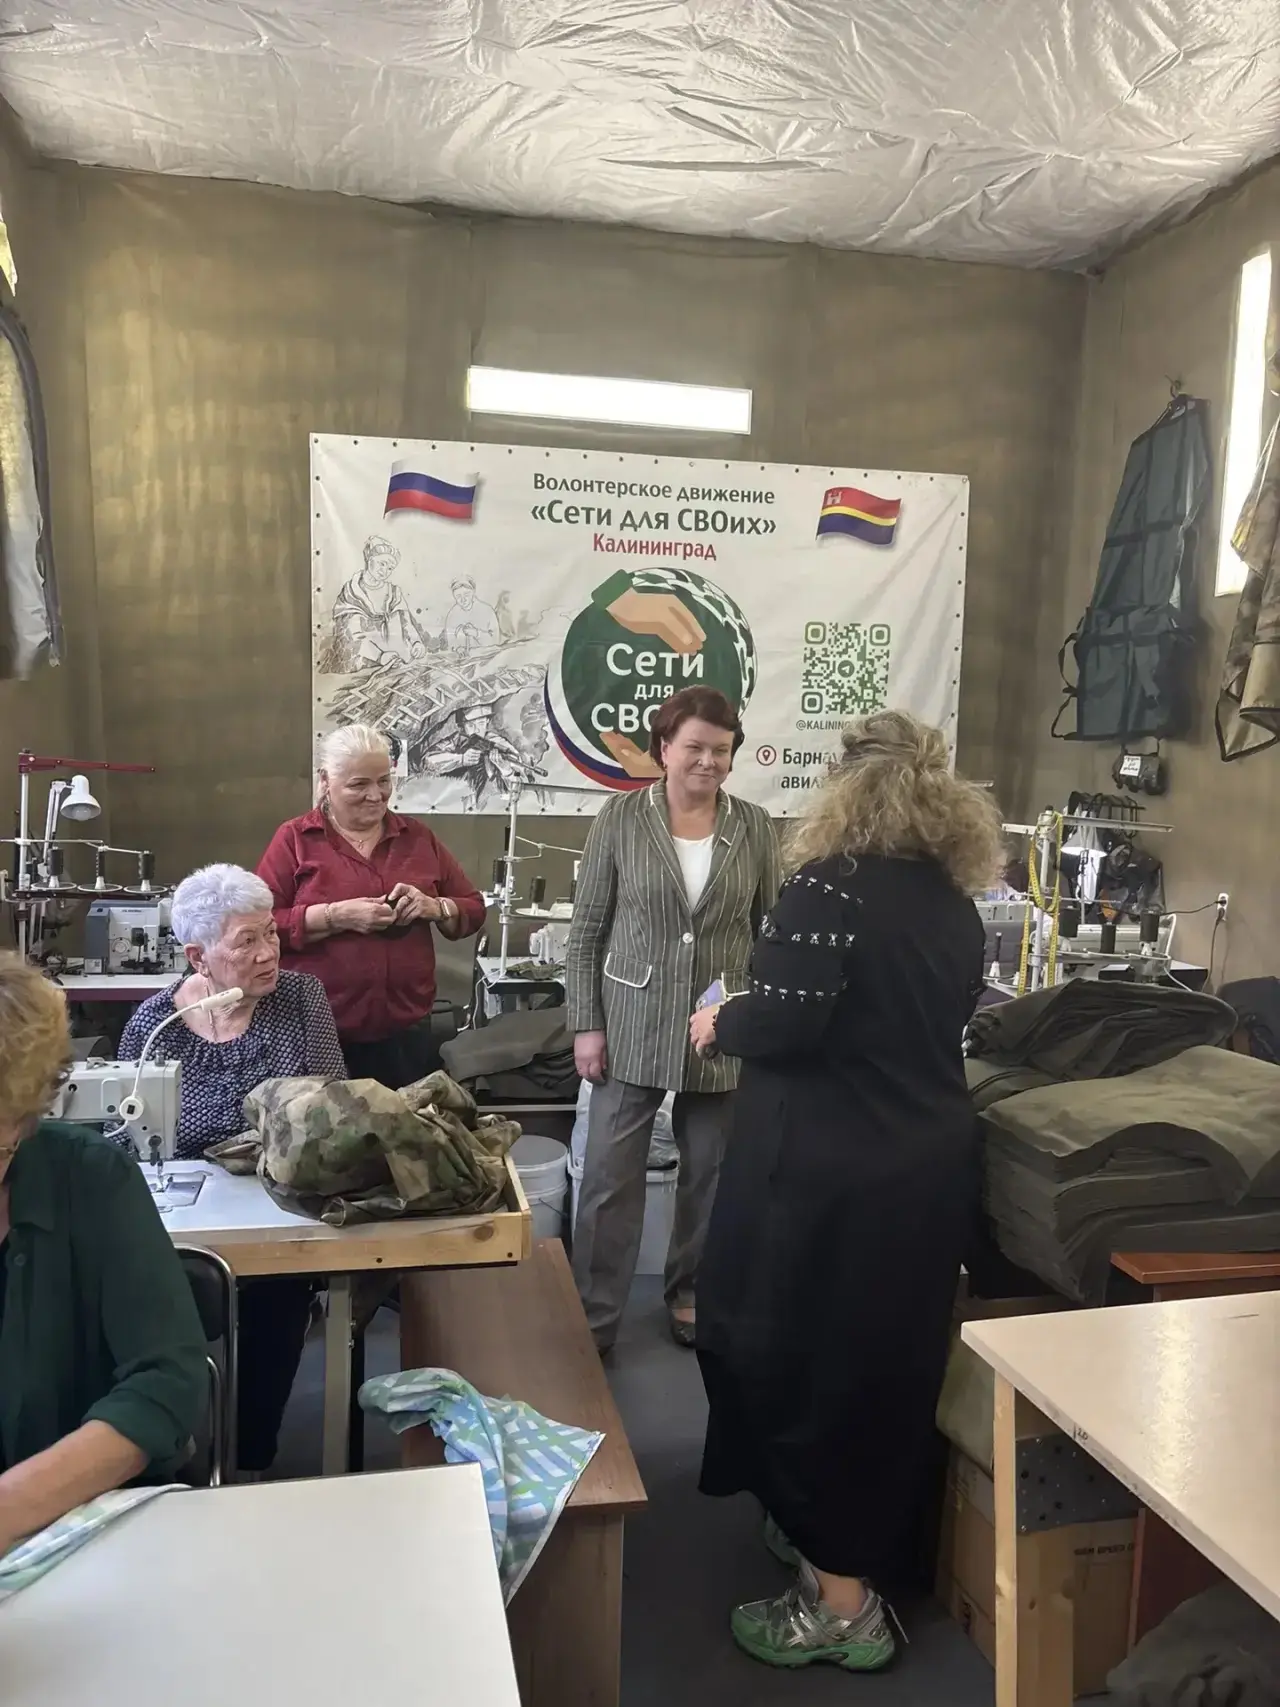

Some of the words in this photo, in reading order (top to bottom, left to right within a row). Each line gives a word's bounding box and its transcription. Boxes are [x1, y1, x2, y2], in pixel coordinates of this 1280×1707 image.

[533, 473, 672, 498] Волонтерское
[677, 487, 775, 504] движение
[531, 499, 612, 526] «Сети
[620, 510, 669, 532] для
[678, 508, 777, 535] СВОих»
[593, 532, 717, 561] Калининград
[606, 642, 705, 679] Сети
[634, 683, 675, 700] для
